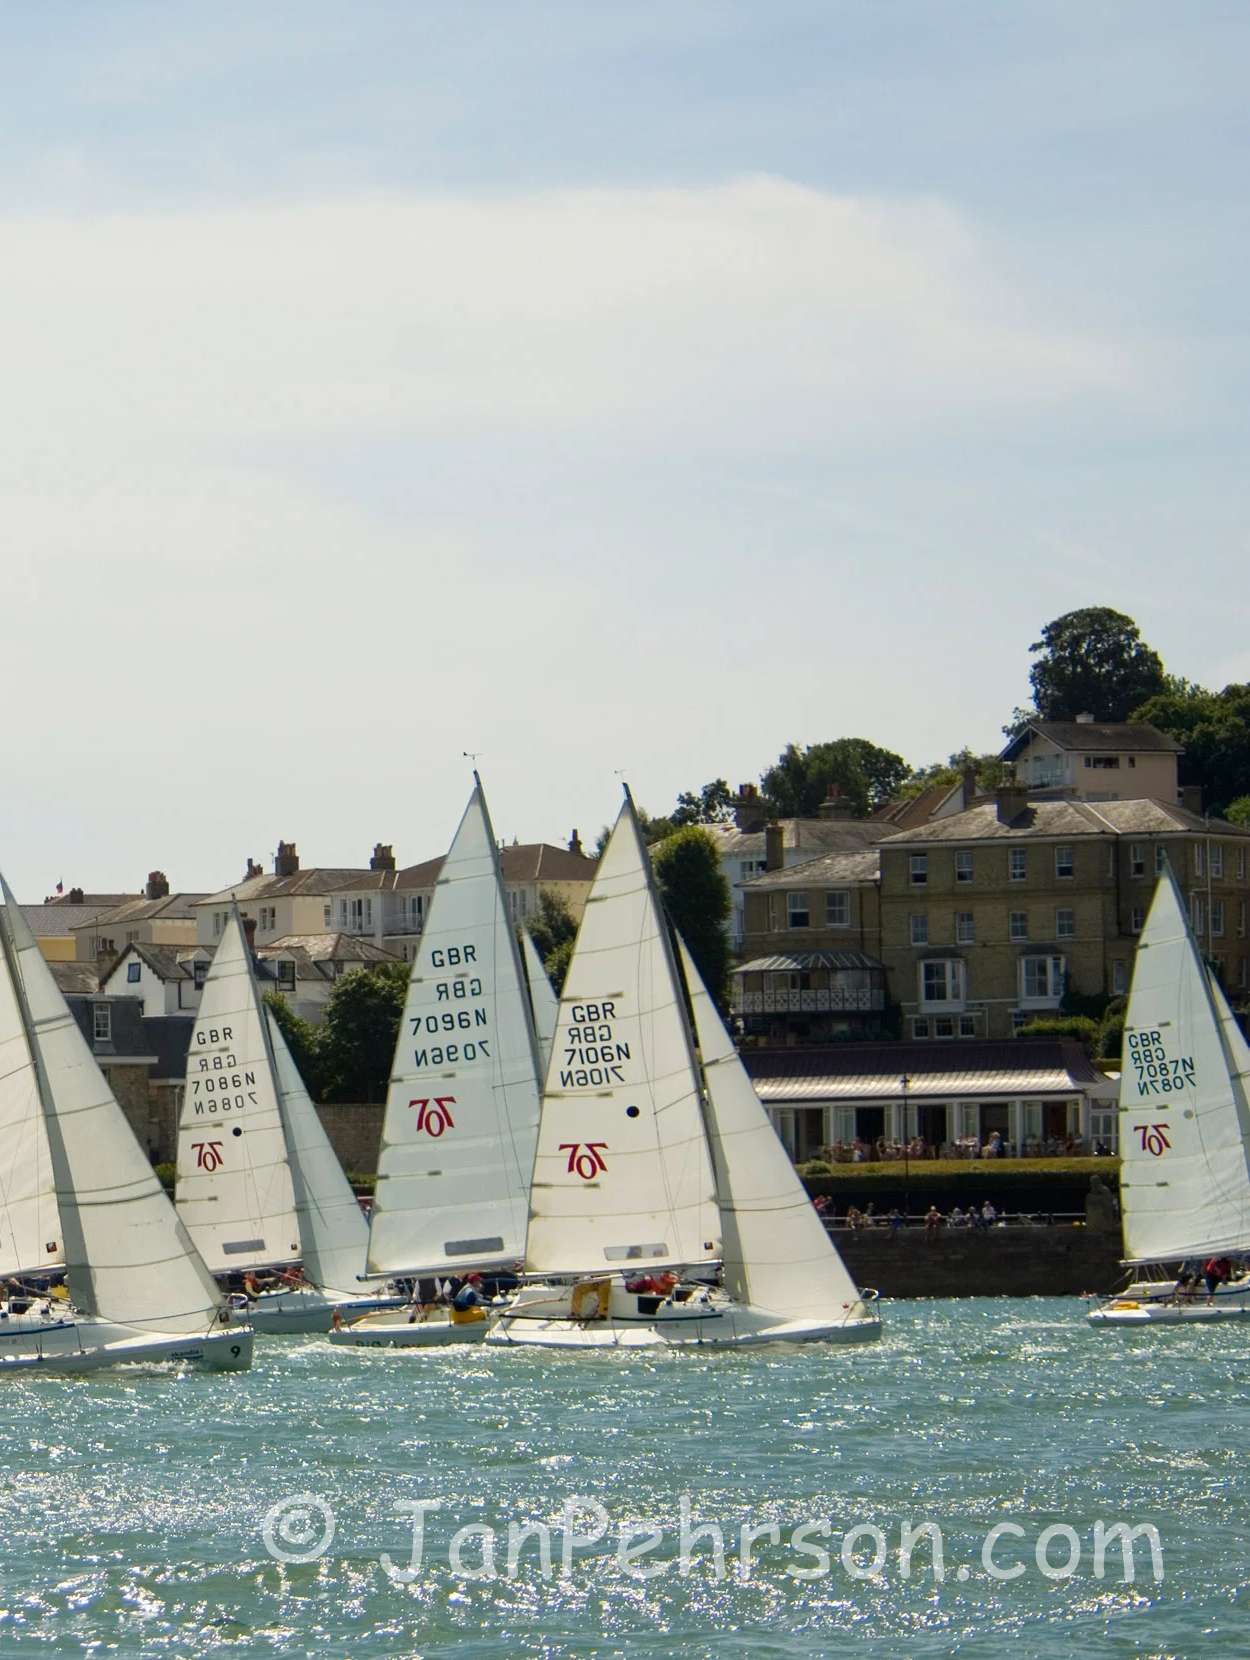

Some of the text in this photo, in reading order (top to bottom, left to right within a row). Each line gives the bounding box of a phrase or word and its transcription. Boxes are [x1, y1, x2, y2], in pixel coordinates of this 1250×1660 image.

[431, 945, 477, 968] GBR
[410, 1008, 487, 1036] 7096N
[572, 1001, 616, 1023] GBR
[197, 1027, 233, 1045] GBR
[564, 1043, 631, 1066] 7106N
[1135, 1056, 1195, 1080] 7087N
[191, 1071, 256, 1095] 7086N
[230, 1345, 241, 1359] 9
